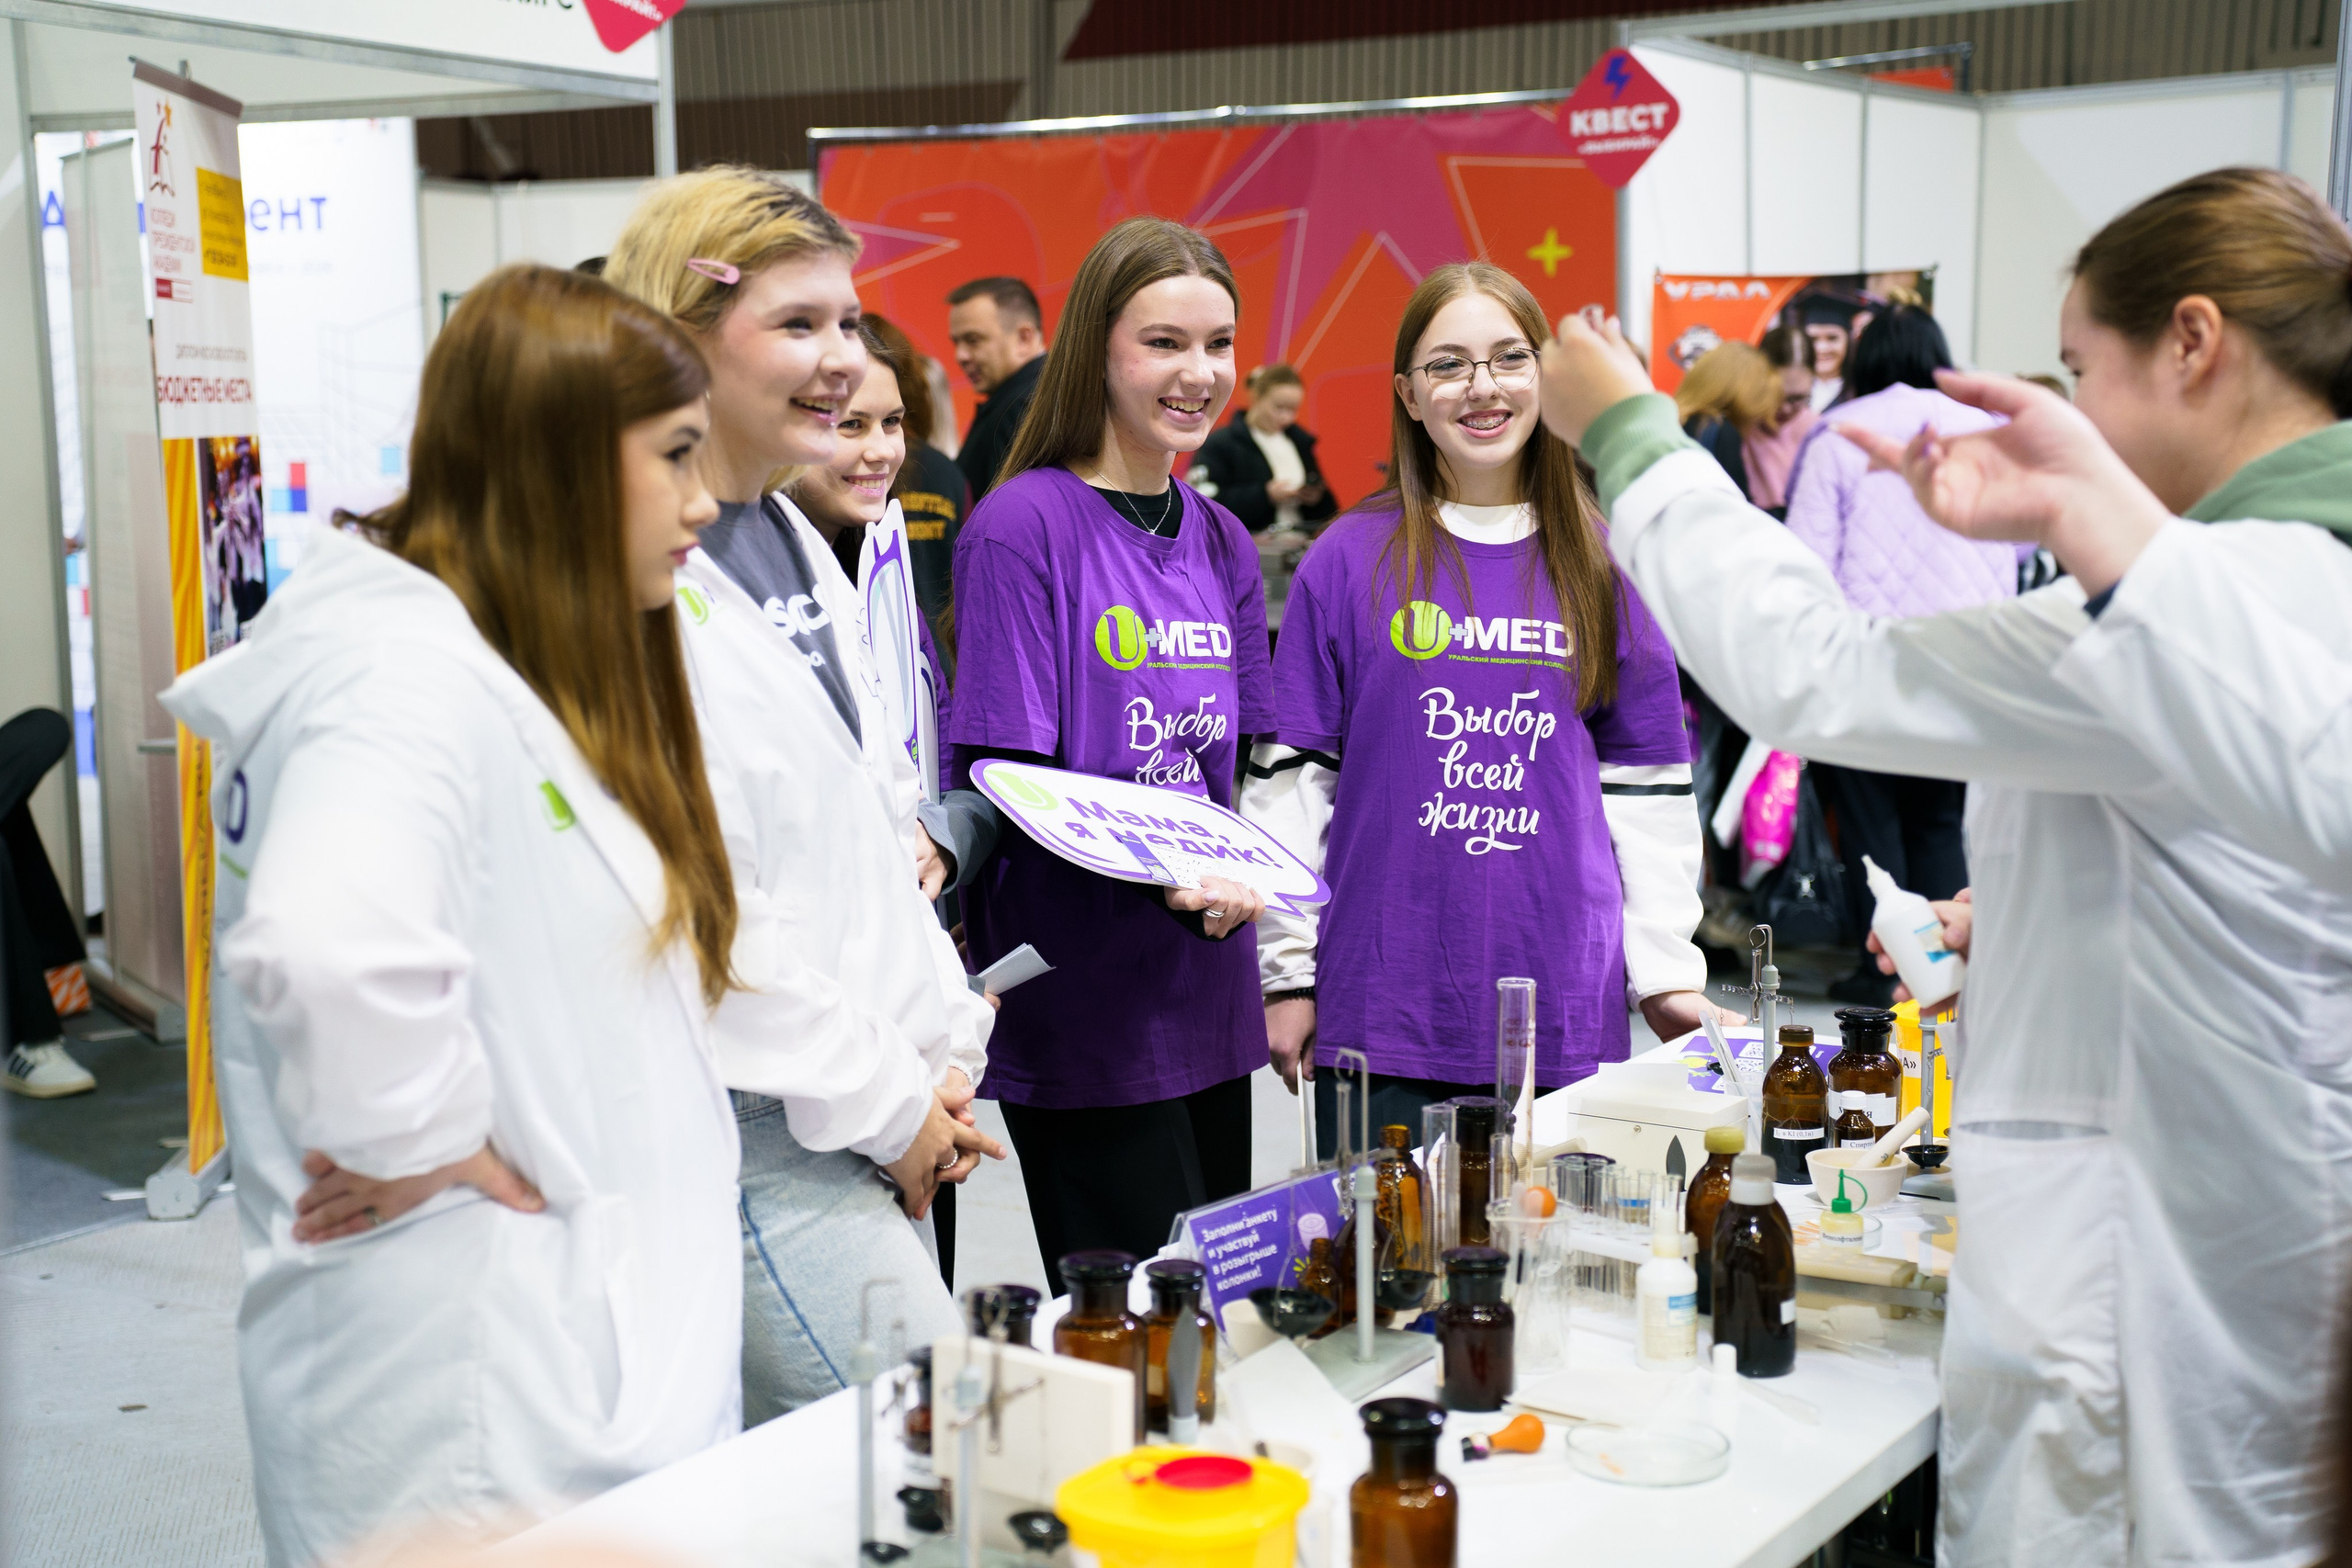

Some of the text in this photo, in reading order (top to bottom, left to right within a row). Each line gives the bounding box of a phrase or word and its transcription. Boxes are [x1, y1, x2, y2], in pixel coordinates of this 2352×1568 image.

[1570, 102, 1669, 137] КВЕСТ
[1448, 654, 1489, 663] УРАЛЬСКИЙ
[1490, 657, 1544, 666] МЕДИЦИНСКИЙ
[1125, 693, 1227, 753] Выбор
[1419, 687, 1556, 761] Выбор
[1438, 740, 1525, 792] всей
[1065, 796, 1231, 844] Мама,
[1419, 792, 1540, 855] жизни
[1064, 821, 1284, 870] я медик!
[1200, 1208, 1278, 1244] Заполни анкету
[1207, 1229, 1261, 1260] и участвуй
[1212, 1244, 1279, 1276] в розыгрыше
[1216, 1264, 1263, 1292] колонки!
